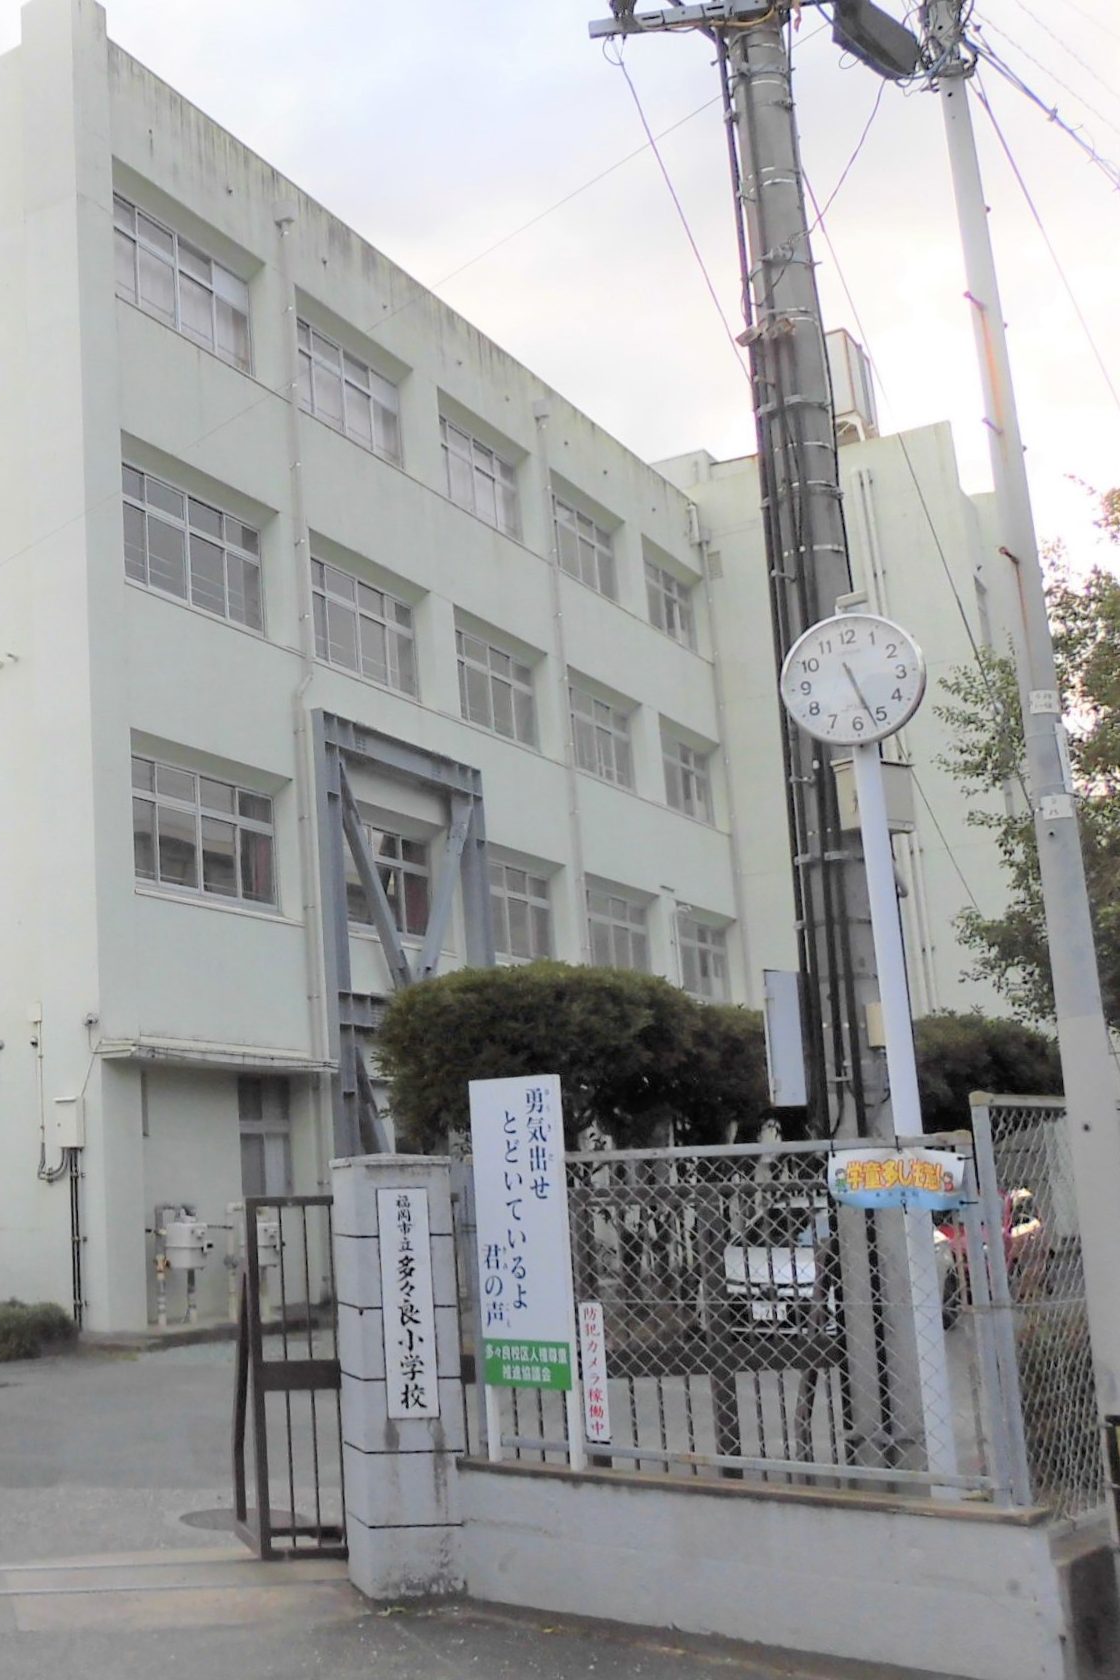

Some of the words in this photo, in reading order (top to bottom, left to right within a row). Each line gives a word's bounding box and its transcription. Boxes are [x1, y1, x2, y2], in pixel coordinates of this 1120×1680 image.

[840, 629, 856, 645] 12
[869, 631, 876, 646] 1
[819, 640, 832, 655] 11
[885, 643, 897, 659] 2
[801, 657, 820, 673] 10
[895, 664, 907, 680] 3
[800, 681, 812, 696] 9
[891, 687, 903, 702] 4
[809, 701, 820, 716] 8
[875, 706, 888, 722] 5
[828, 714, 838, 730] 7
[852, 716, 864, 732] 6
[525, 1087, 550, 1200] 勇気出せ
[503, 1109, 528, 1310] とどいているよ
[482, 1244, 504, 1328] 君の声
[396, 1194, 428, 1409] 福岡市立多々良小学校
[583, 1307, 605, 1436] 防犯カメラ稼働中
